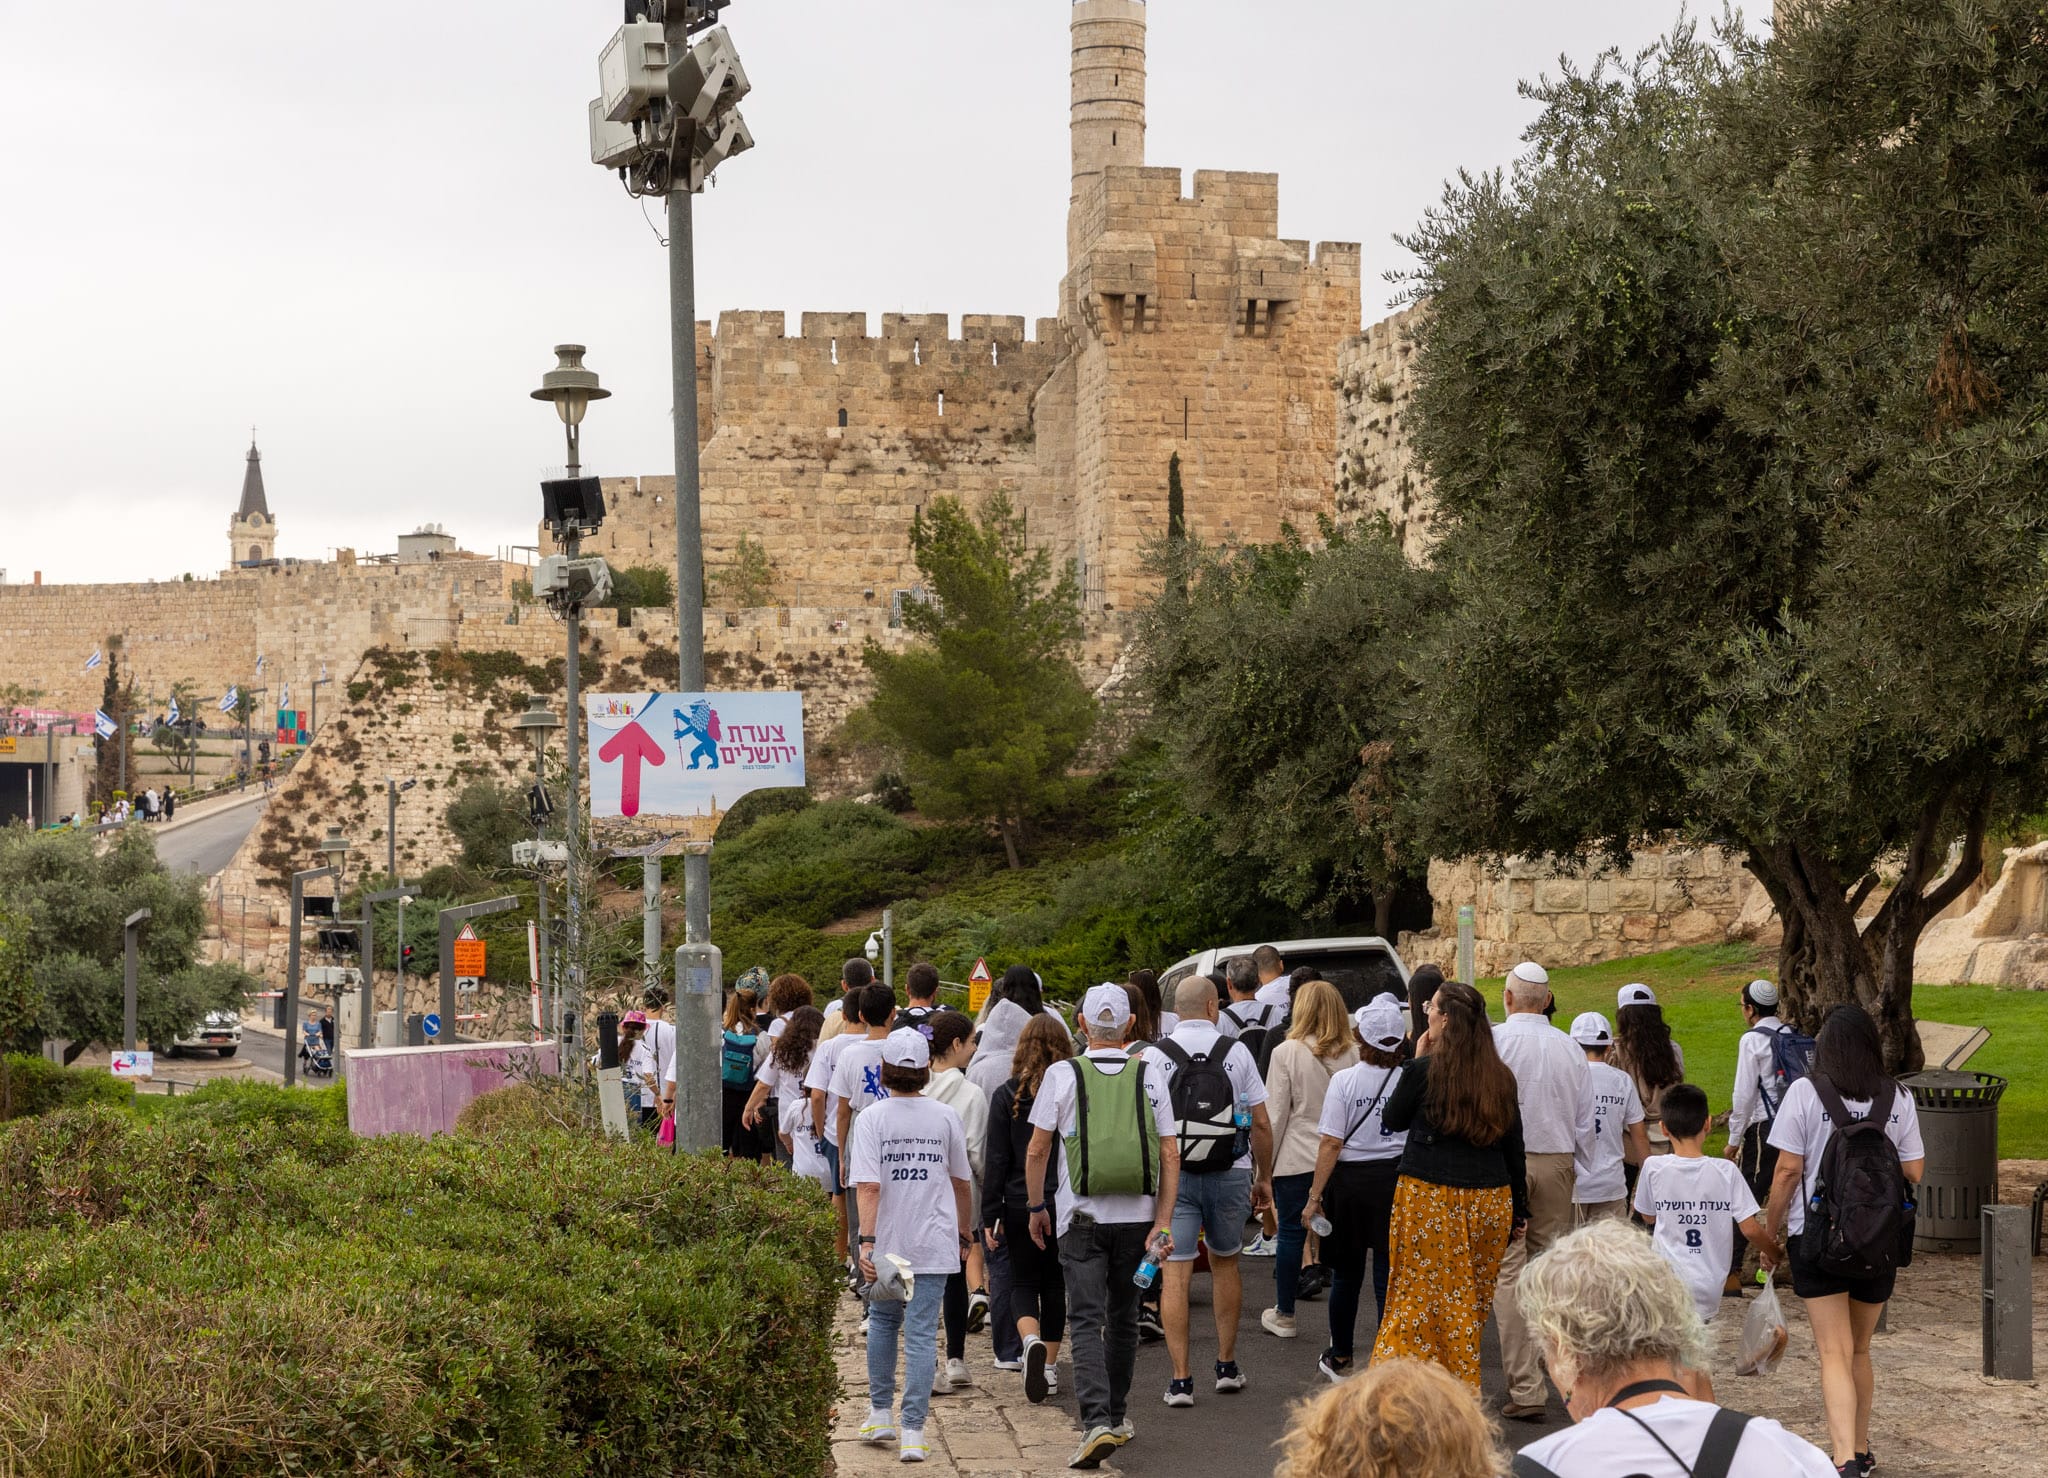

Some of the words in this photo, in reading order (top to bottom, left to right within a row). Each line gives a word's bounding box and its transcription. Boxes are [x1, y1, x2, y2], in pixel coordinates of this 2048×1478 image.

[727, 725, 786, 743] צעדת
[719, 743, 797, 764] ירושלים
[1601, 1095, 1625, 1105] צעדת
[1595, 1106, 1607, 1115] 23
[891, 1168, 929, 1181] 2023
[1655, 1199, 1696, 1211] ירושלים
[1699, 1200, 1731, 1211] צעדת
[1678, 1214, 1707, 1225] 2023
